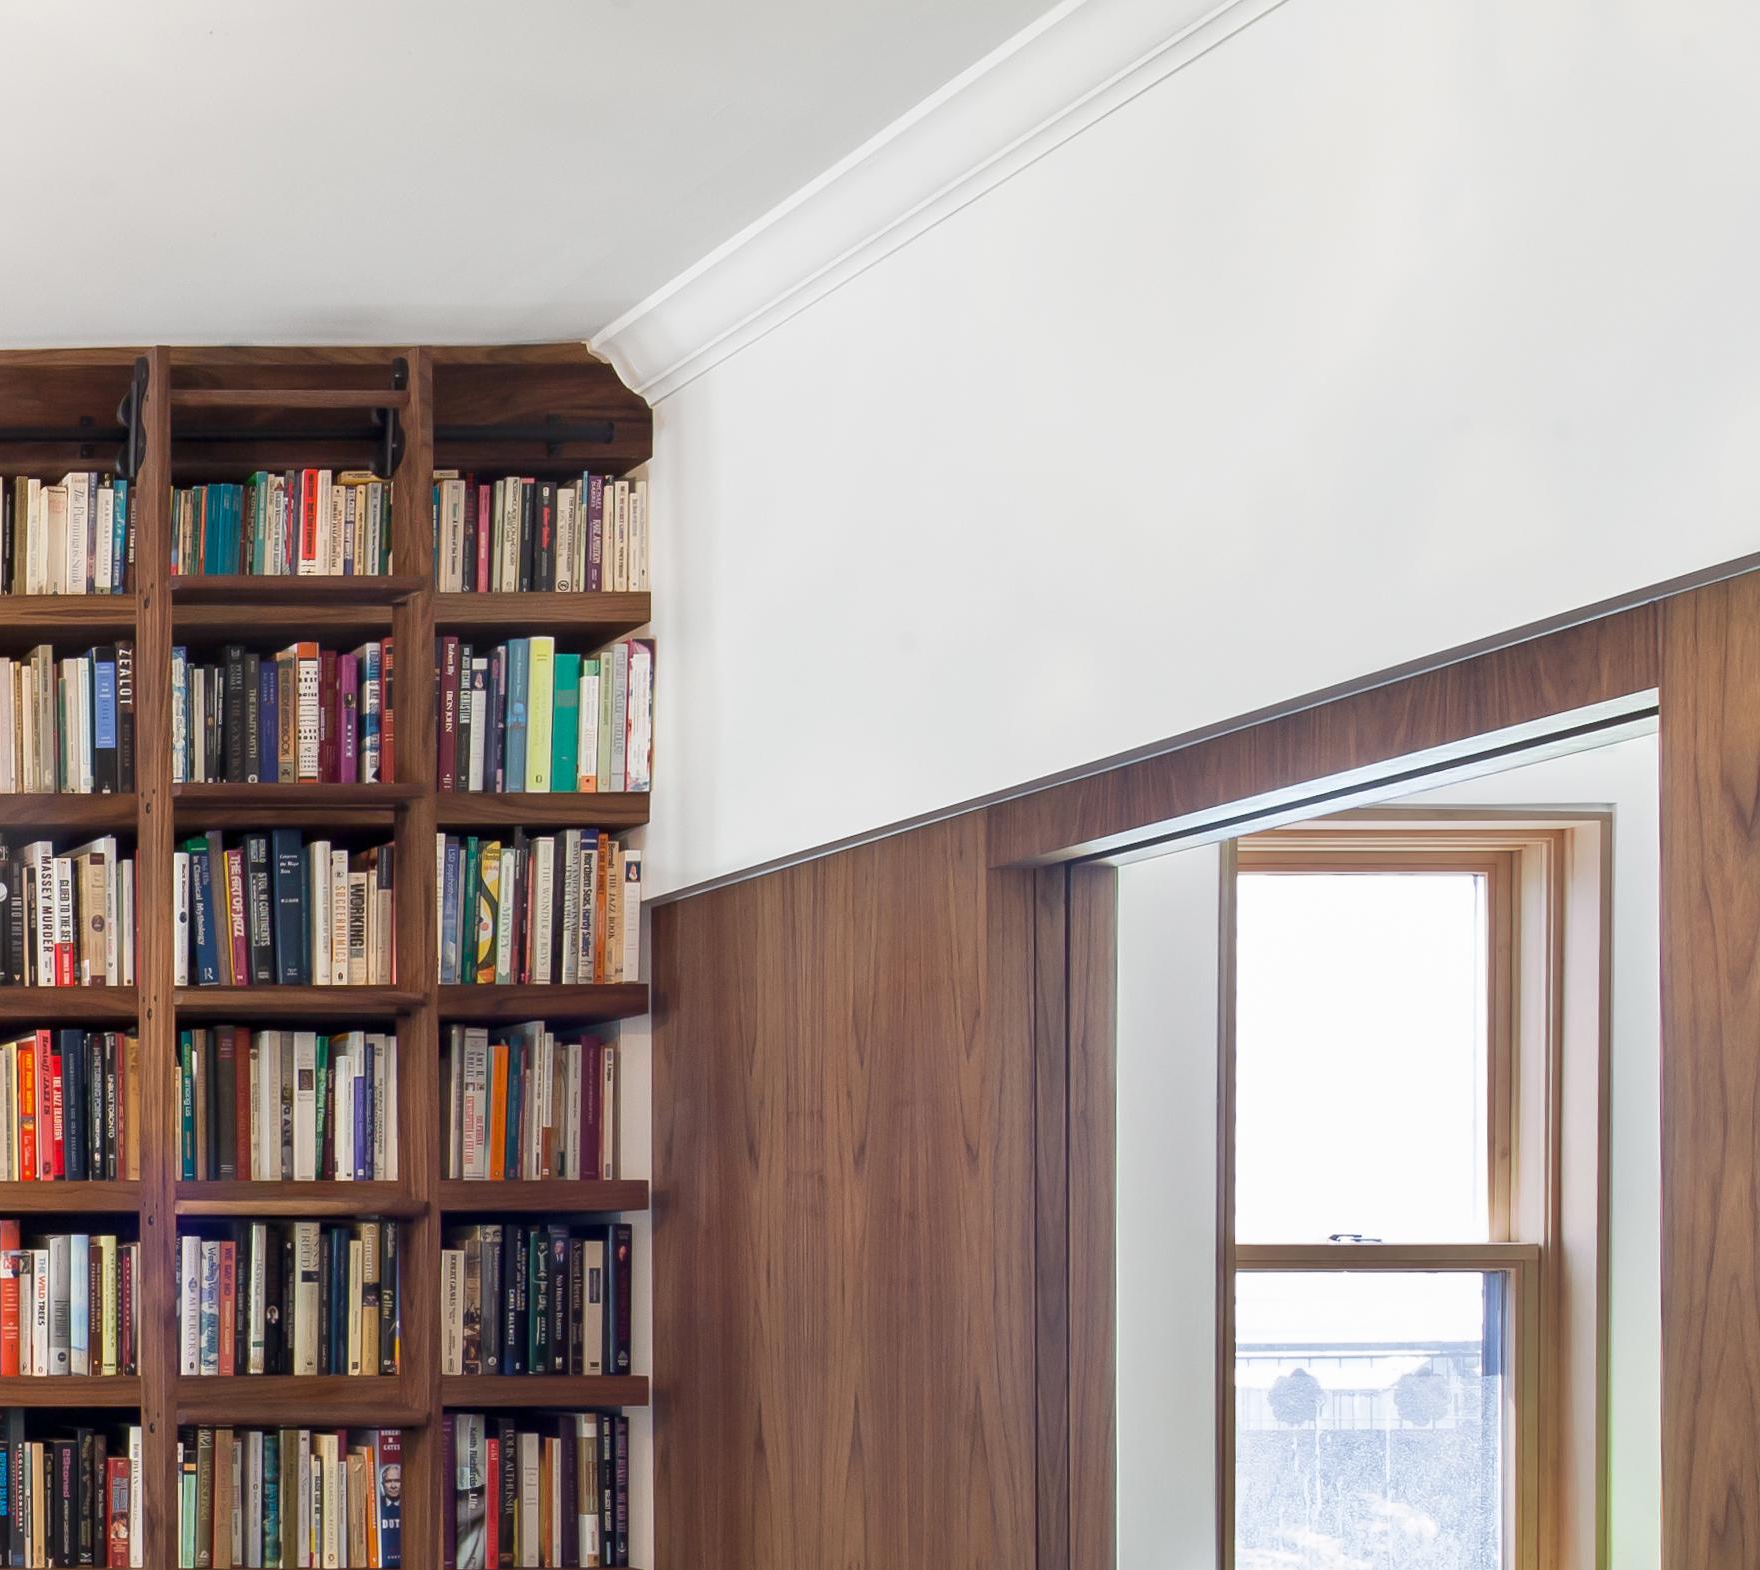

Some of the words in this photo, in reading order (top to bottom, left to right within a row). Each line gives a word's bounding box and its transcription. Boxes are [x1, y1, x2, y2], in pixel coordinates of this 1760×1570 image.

[119, 650, 132, 705] ZEALOT
[41, 856, 53, 900] MASSEY
[230, 856, 243, 876] THE
[582, 853, 592, 886] Northern
[230, 878, 243, 895] ART
[608, 873, 616, 889] THE
[230, 898, 243, 911] OF
[582, 889, 592, 906] Seas,
[608, 893, 616, 913] JAZZ
[230, 914, 243, 936] JAZZ
[335, 885, 346, 963] SOCCERNOMICS
[350, 884, 365, 947] WORKING
[582, 909, 592, 929] Hardy
[608, 916, 616, 939] BOOK
[41, 907, 53, 952] MURDER
[500, 906, 510, 950] MONEY
[582, 932, 592, 957] Sailors
[301, 1228, 311, 1268] FREUD
[364, 1224, 375, 1280] Clemente
[37, 1258, 45, 1273] THE
[37, 1275, 45, 1299] WILD
[37, 1301, 45, 1326] TREES
[188, 1297, 197, 1357] MIRRORS
[469, 1427, 477, 1448] Keith
[469, 1451, 477, 1486] Richards
[469, 1493, 477, 1509] Life
